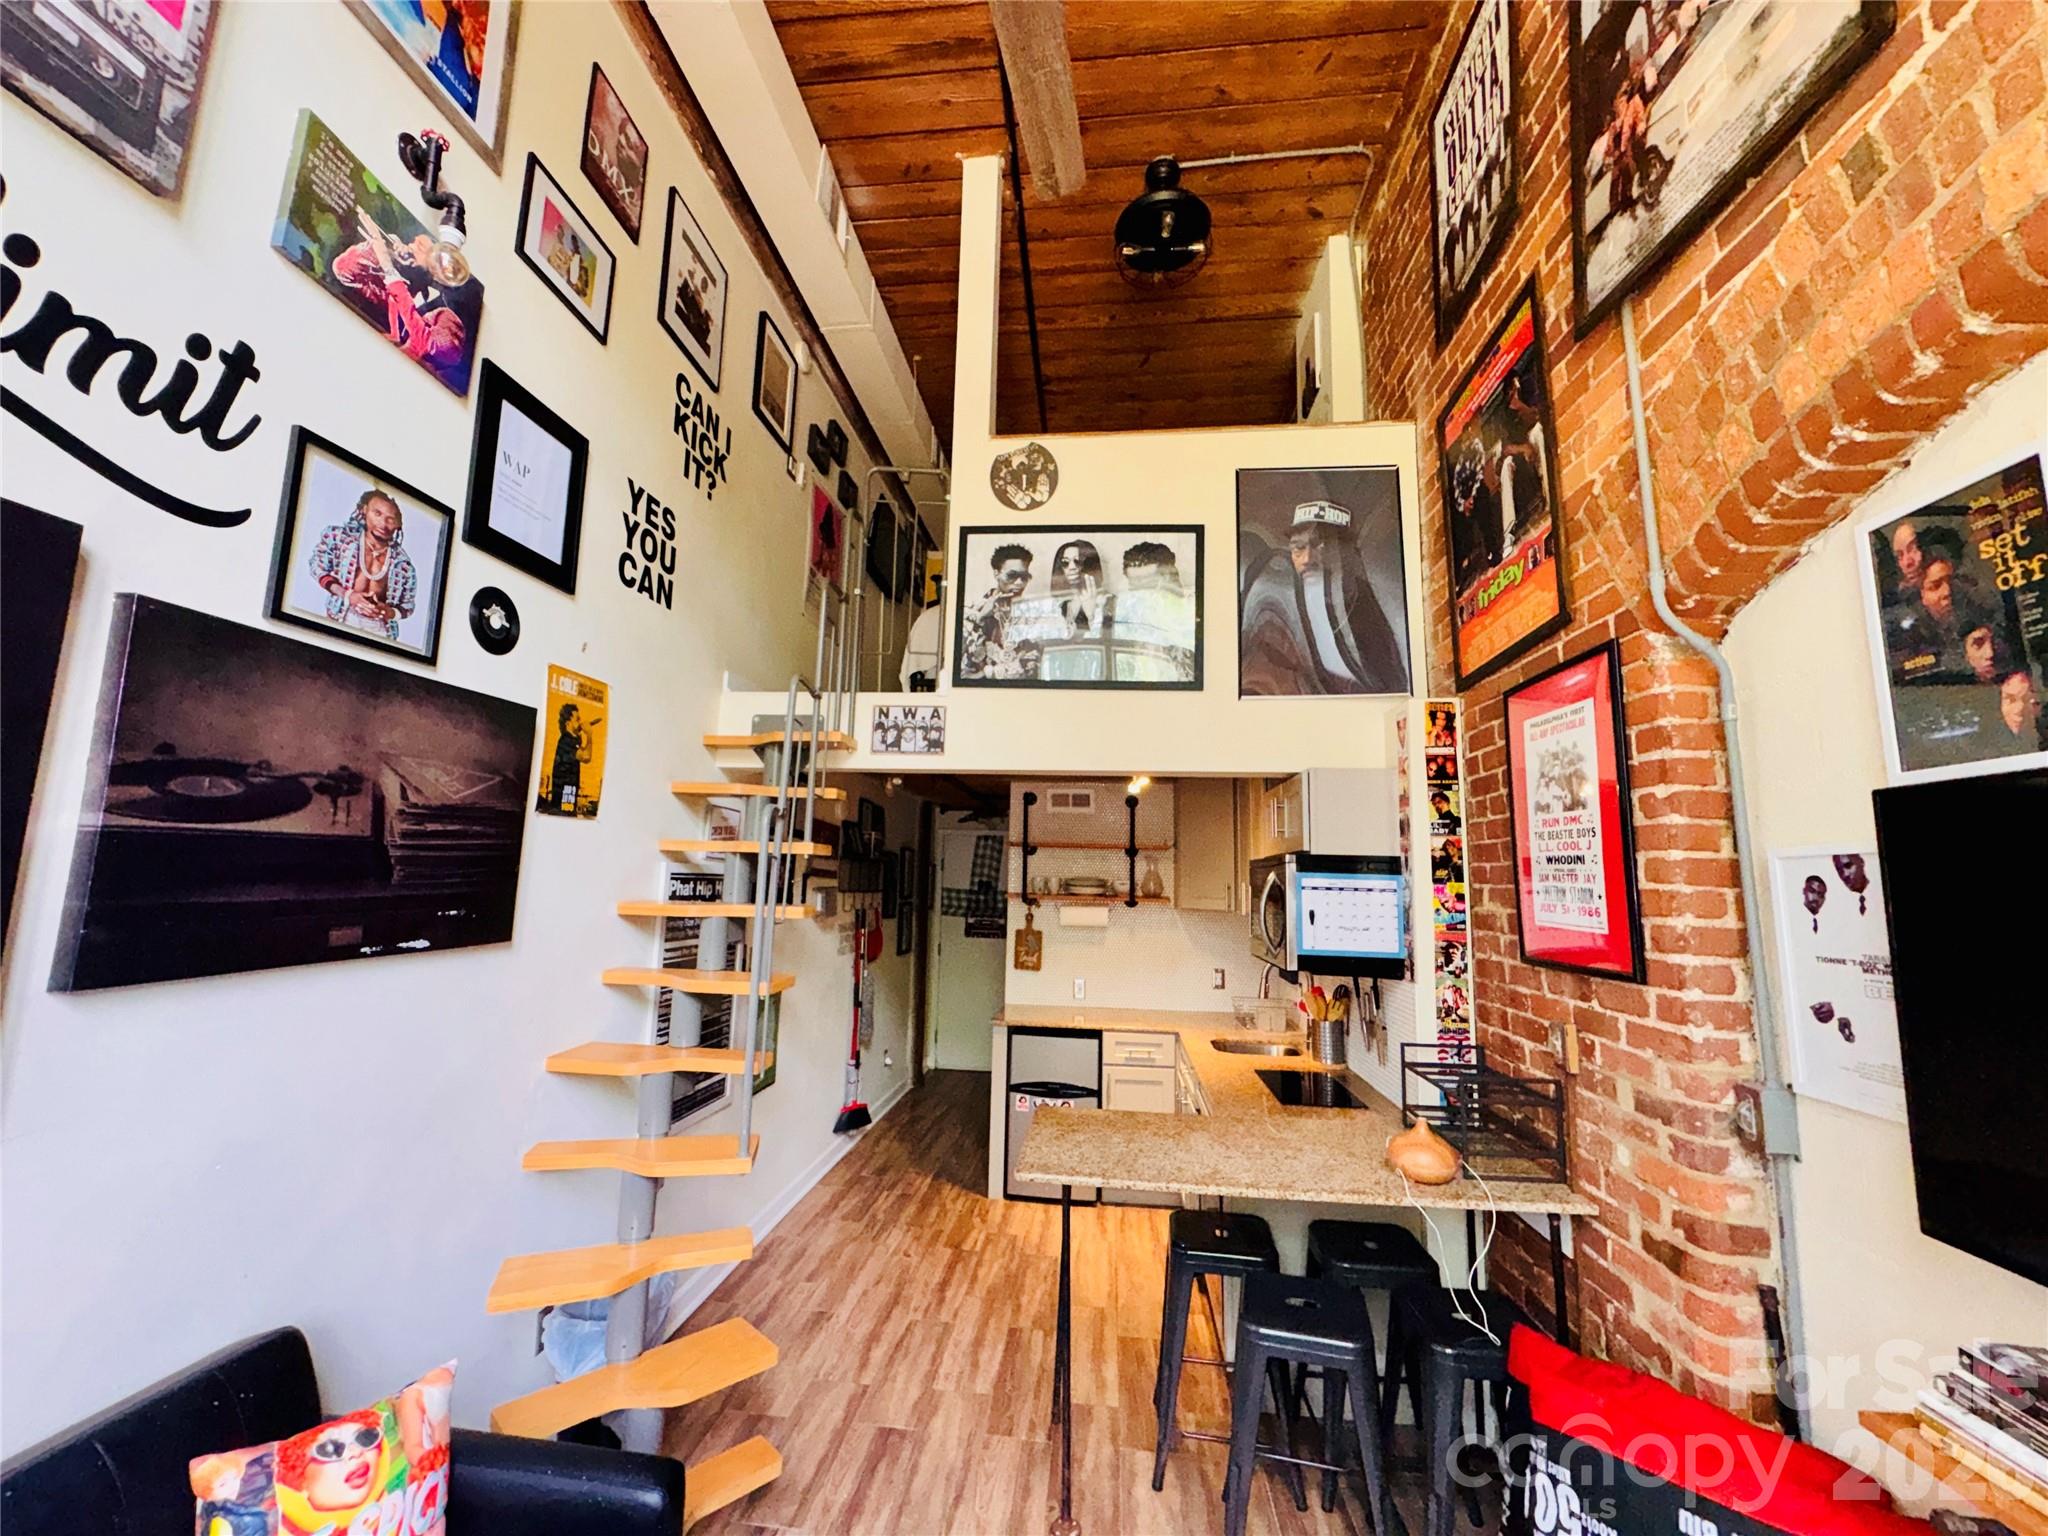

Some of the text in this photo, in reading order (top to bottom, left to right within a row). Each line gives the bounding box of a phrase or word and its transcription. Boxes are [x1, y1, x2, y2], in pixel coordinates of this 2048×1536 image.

[437, 58, 472, 104] STALLION
[1448, 44, 1500, 187] OUTTA
[0, 232, 261, 452] imit
[676, 373, 732, 455] CAN I
[674, 403, 728, 484] KICK
[503, 450, 531, 478] WAP
[684, 448, 718, 501] IT?
[627, 476, 677, 542] YES
[622, 511, 677, 575] YOU
[1978, 523, 2032, 560] set
[1992, 549, 2017, 574] it
[1995, 553, 2048, 591] off
[618, 551, 674, 611] CAN
[1535, 826, 1597, 841] THE BEASTIE BOYS
[1542, 814, 1583, 829] RUN DMC
[1545, 854, 1586, 866] WHODINI
[1556, 840, 1582, 852] COOL
[1586, 838, 1592, 851] J
[669, 879, 695, 897] Phat
[696, 881, 713, 900] Hip
[1538, 872, 1598, 885] JAM MASTER JAY
[1540, 902, 1558, 914] JULY
[1577, 906, 1602, 919] 1986
[1815, 956, 1848, 966] TIONNE
[1862, 984, 1894, 1001] BE
